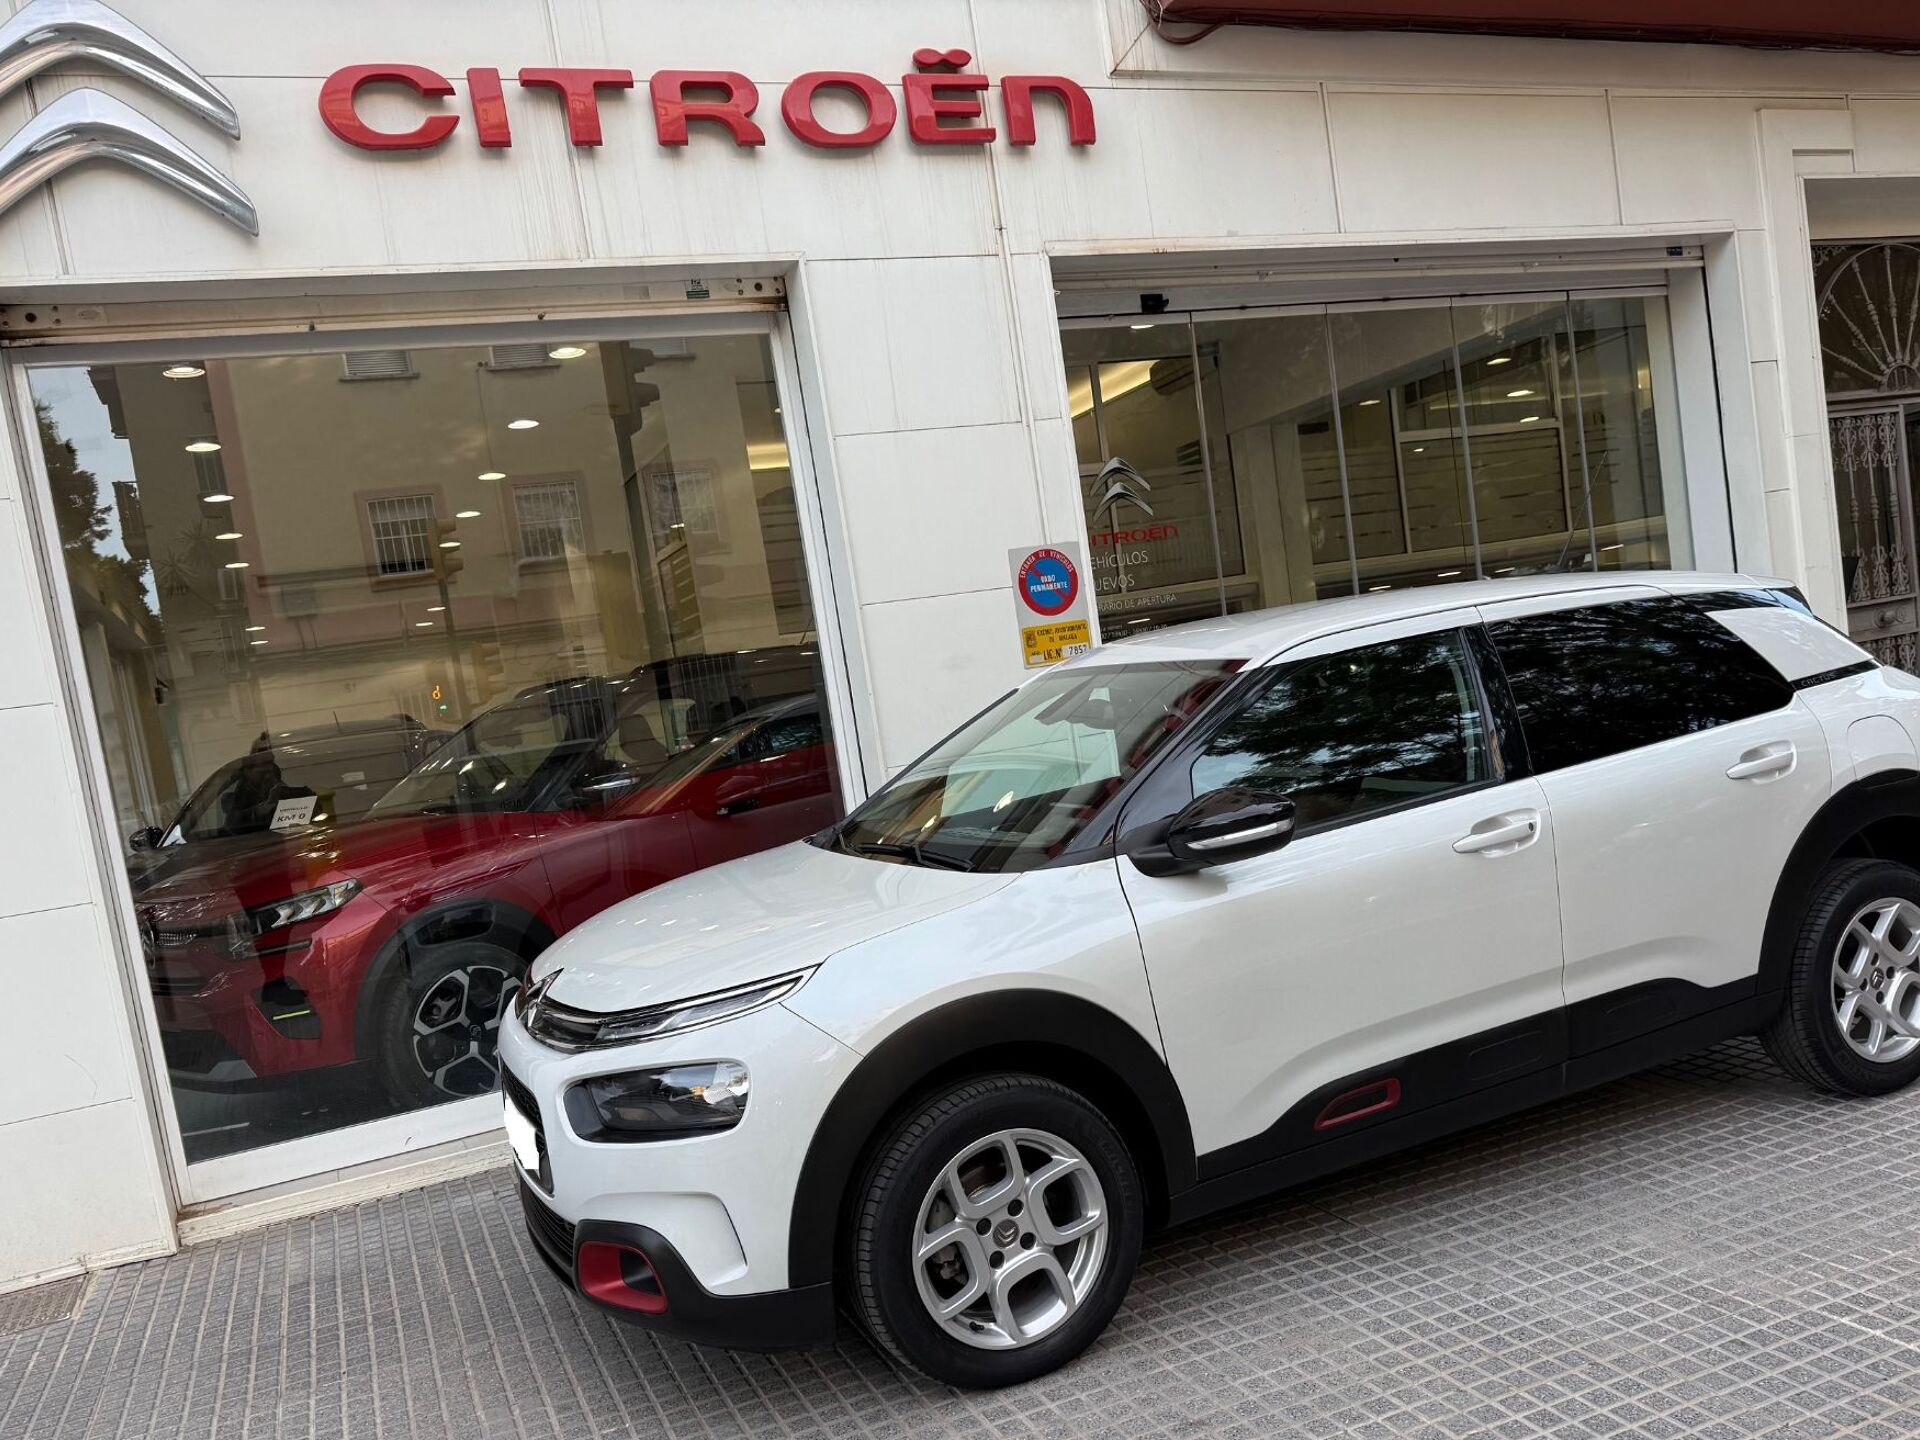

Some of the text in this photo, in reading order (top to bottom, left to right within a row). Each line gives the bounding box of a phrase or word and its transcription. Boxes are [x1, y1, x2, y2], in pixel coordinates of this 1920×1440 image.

[318, 48, 1096, 151] CITROËN
[1091, 524, 1179, 546] ITROËN
[1090, 550, 1149, 570] EHÍCULOS
[1030, 581, 1068, 593] PERMANENTE
[1040, 574, 1056, 584] VADO
[1095, 573, 1135, 592] UEVOS
[1124, 599, 1135, 609] DE
[1137, 593, 1178, 607] APERTURA
[1801, 671, 1837, 687] CACTUS
[277, 814, 296, 822] KM
